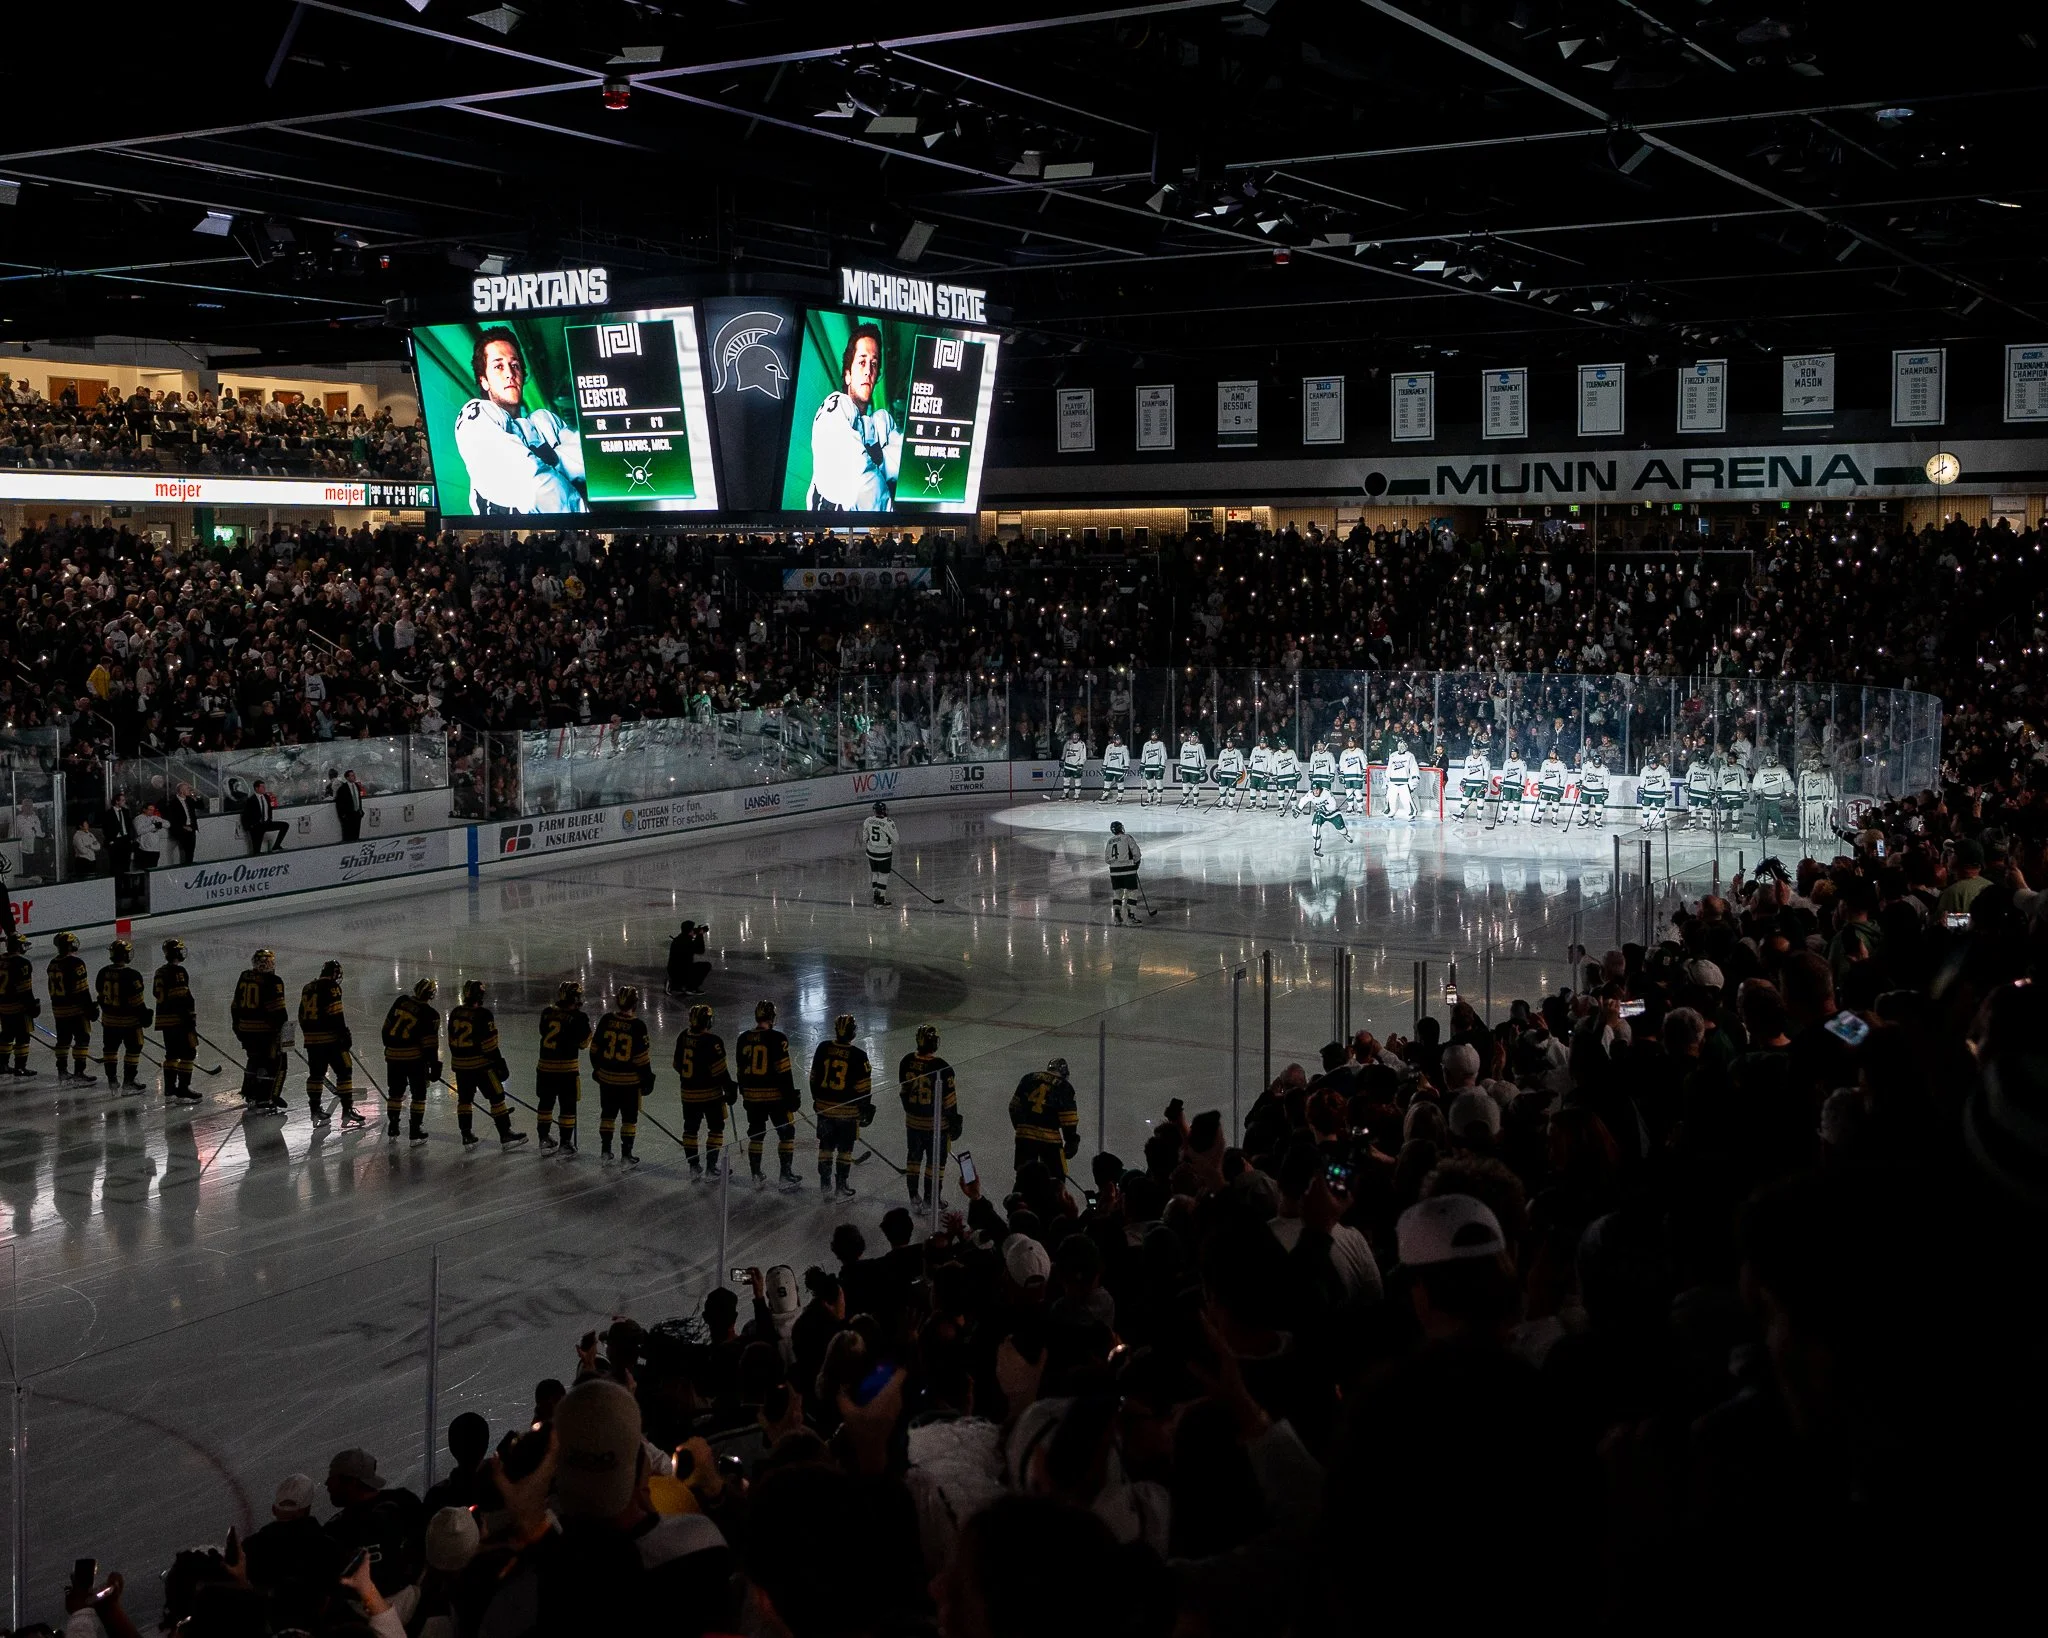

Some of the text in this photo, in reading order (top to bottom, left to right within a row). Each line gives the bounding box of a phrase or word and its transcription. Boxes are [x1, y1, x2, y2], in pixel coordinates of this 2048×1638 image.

[472, 268, 609, 313] SPARTANS
[841, 267, 987, 322] MICHIGAN STATE
[1801, 368, 1816, 378] RON
[1900, 366, 1938, 375] CHAMPIONS
[577, 375, 609, 388] REED
[913, 382, 934, 395] REED
[1586, 380, 1617, 388] TOURNAMENT
[1685, 376, 1720, 385] FROZEN FOUR
[1795, 378, 1822, 387] MASON
[580, 388, 628, 408] LEBSTER
[910, 395, 943, 414] LEBSTER
[1436, 454, 1868, 495] MUNN ARENA
[155, 478, 202, 503] meijer
[325, 483, 365, 507] meijer
[853, 771, 899, 793] WOW!
[950, 783, 985, 791] NETWORK
[638, 806, 669, 818] MICHIGAN
[672, 803, 686, 813] For
[539, 811, 606, 832] FARM BUREAU
[638, 816, 669, 830] LOTTERY
[673, 815, 686, 826] For
[546, 827, 601, 846] INSURANCE
[871, 826, 880, 842] 5
[339, 850, 404, 869] Shaheen
[1111, 843, 1119, 859] 4
[185, 864, 290, 890] Auto-Owners
[207, 881, 269, 899] INSURANCE
[240, 982, 260, 1009] 30
[543, 1020, 561, 1049] 2
[603, 1030, 633, 1062] 33
[682, 1048, 694, 1079] 5
[821, 1059, 848, 1092] 13
[1027, 1083, 1049, 1114] 4
